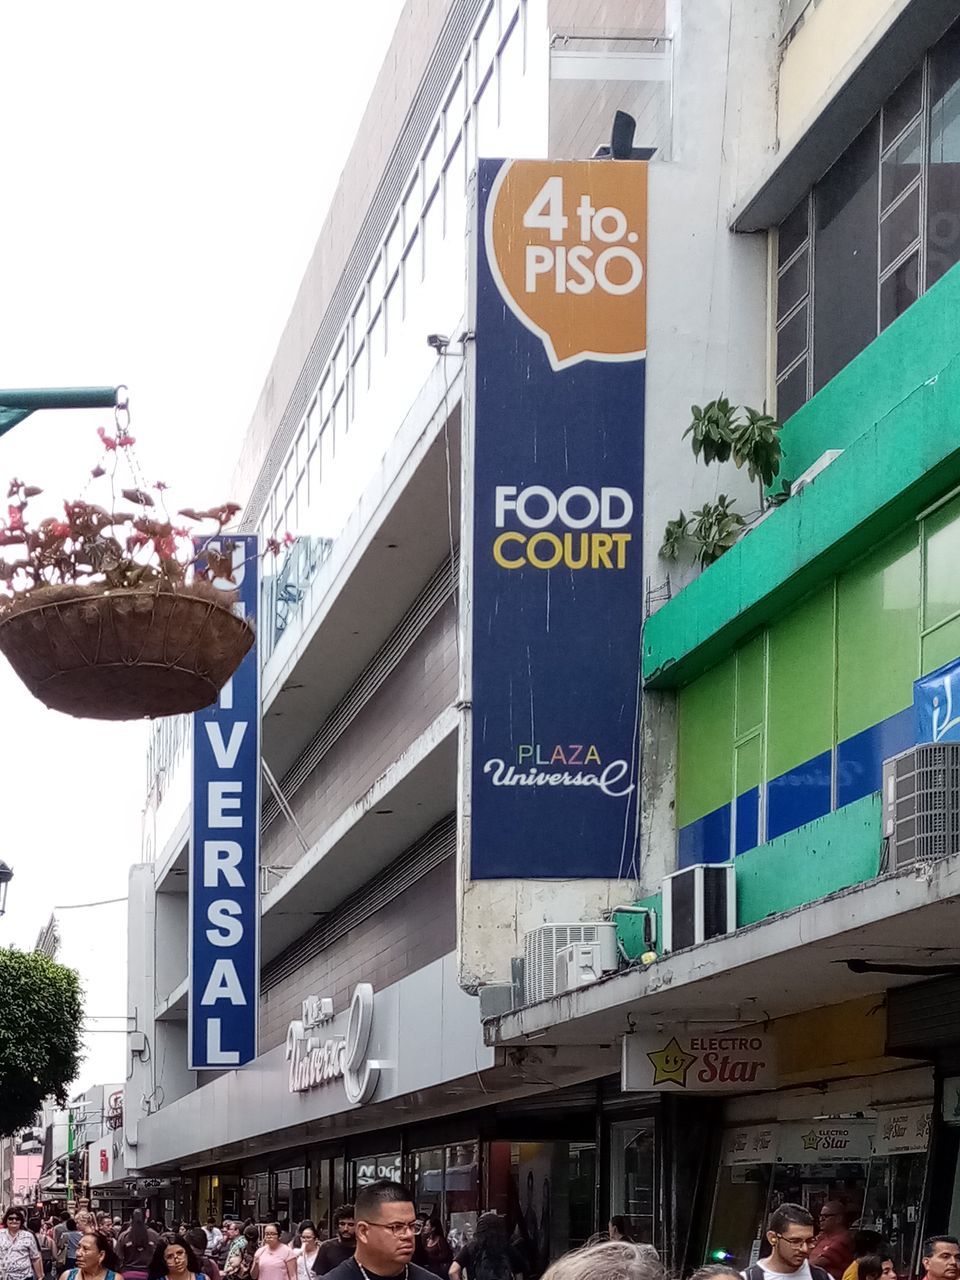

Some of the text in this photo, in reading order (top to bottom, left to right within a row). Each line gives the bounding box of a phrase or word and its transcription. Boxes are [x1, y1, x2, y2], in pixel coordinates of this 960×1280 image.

[523, 176, 639, 243] 4 to.
[525, 245, 643, 296] PISO
[495, 485, 634, 529] FOOD
[493, 531, 632, 570] COURT
[518, 745, 601, 765] PLAZA
[483, 758, 635, 797] Universal
[200, 541, 249, 1064] UIVERSAL
[690, 1038, 762, 1050] ELECTRO
[698, 1052, 766, 1083] Star
[822, 1137, 850, 1149] Star
